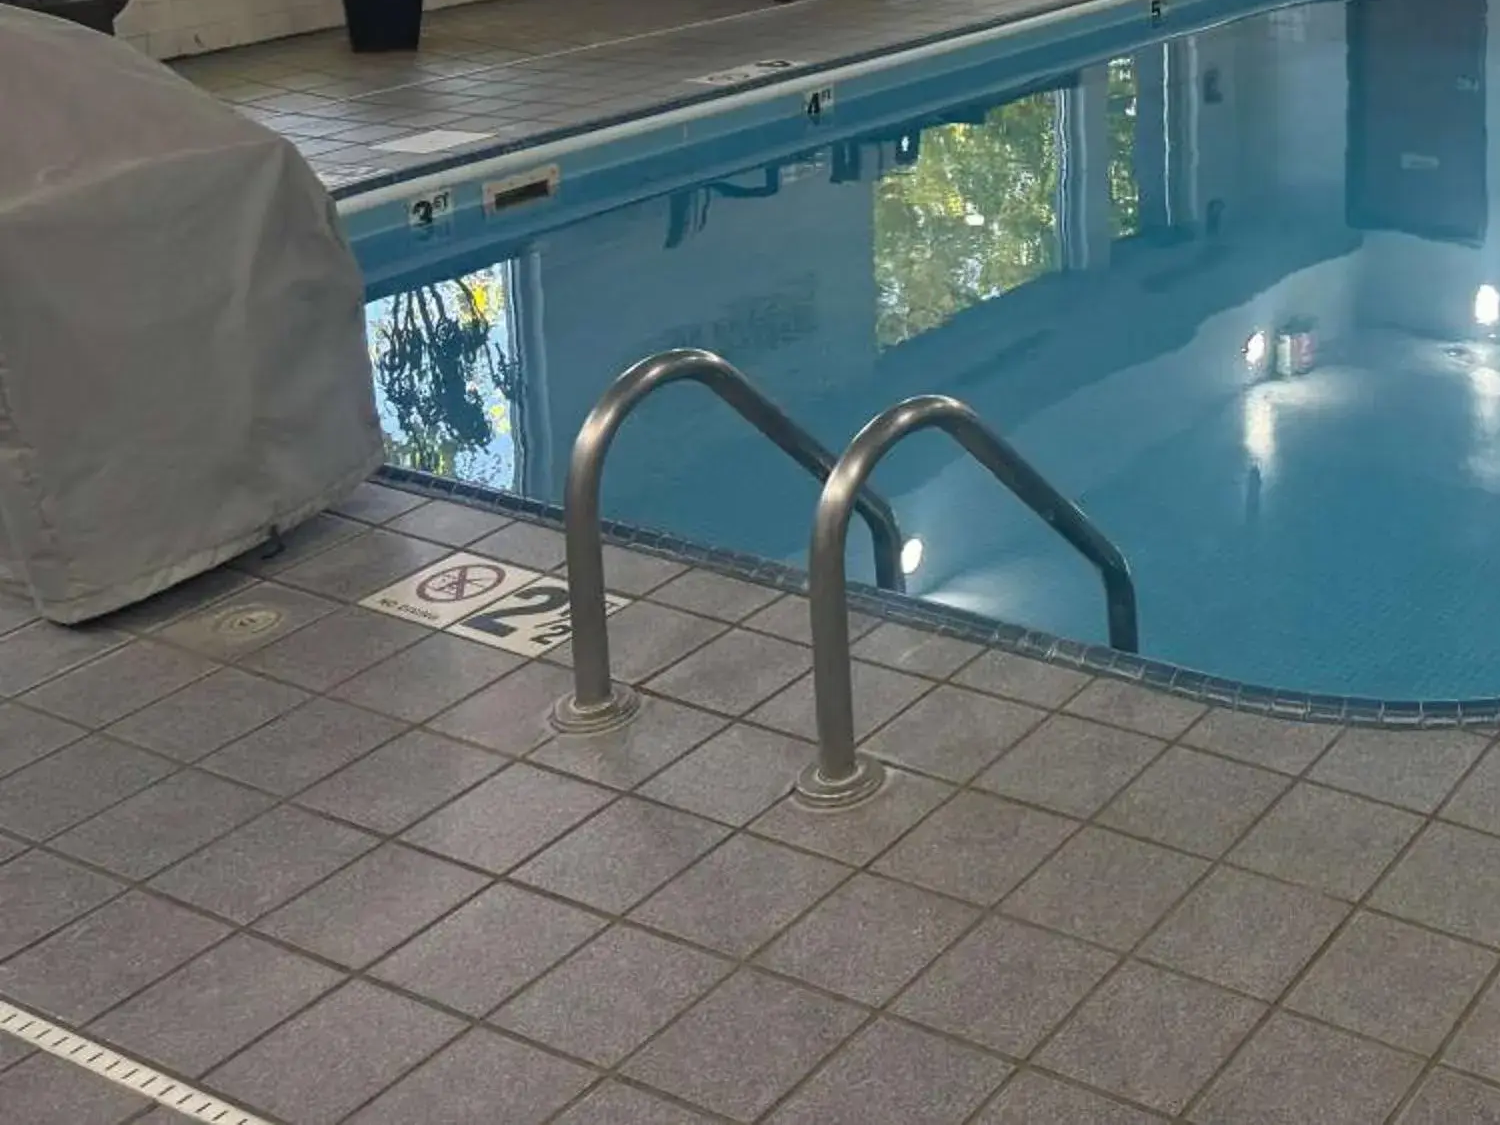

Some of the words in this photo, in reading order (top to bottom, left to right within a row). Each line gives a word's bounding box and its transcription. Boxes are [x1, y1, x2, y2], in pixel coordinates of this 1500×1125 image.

[1151, 0, 1161, 20] 5
[807, 92, 820, 114] 4
[412, 200, 432, 226] 3
[459, 586, 571, 637] 2
